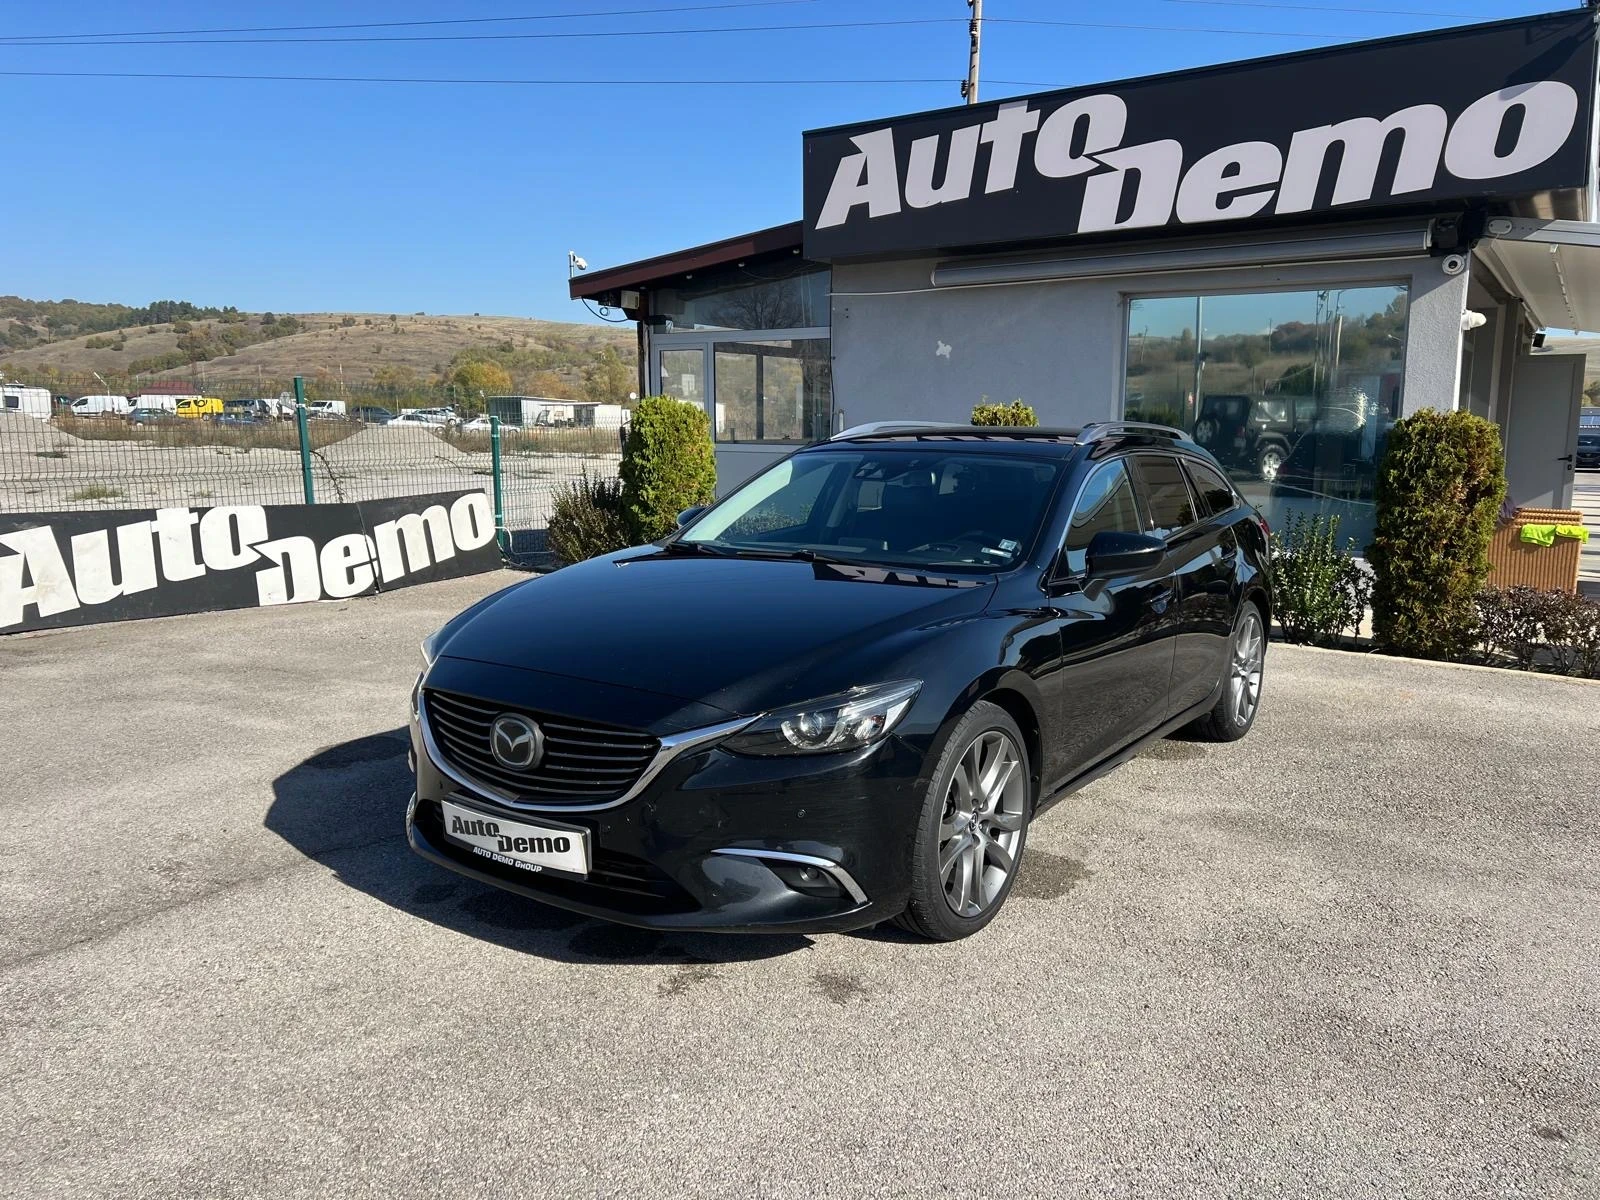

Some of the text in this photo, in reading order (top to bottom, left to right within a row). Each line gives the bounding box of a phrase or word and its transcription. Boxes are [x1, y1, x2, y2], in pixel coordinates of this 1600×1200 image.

[815, 81, 1578, 233] Auto Demo
[0, 493, 496, 628] Auto Demo
[452, 815, 571, 853] Auto Demo
[473, 847, 491, 858] AUTO
[492, 853, 514, 866] DEMO
